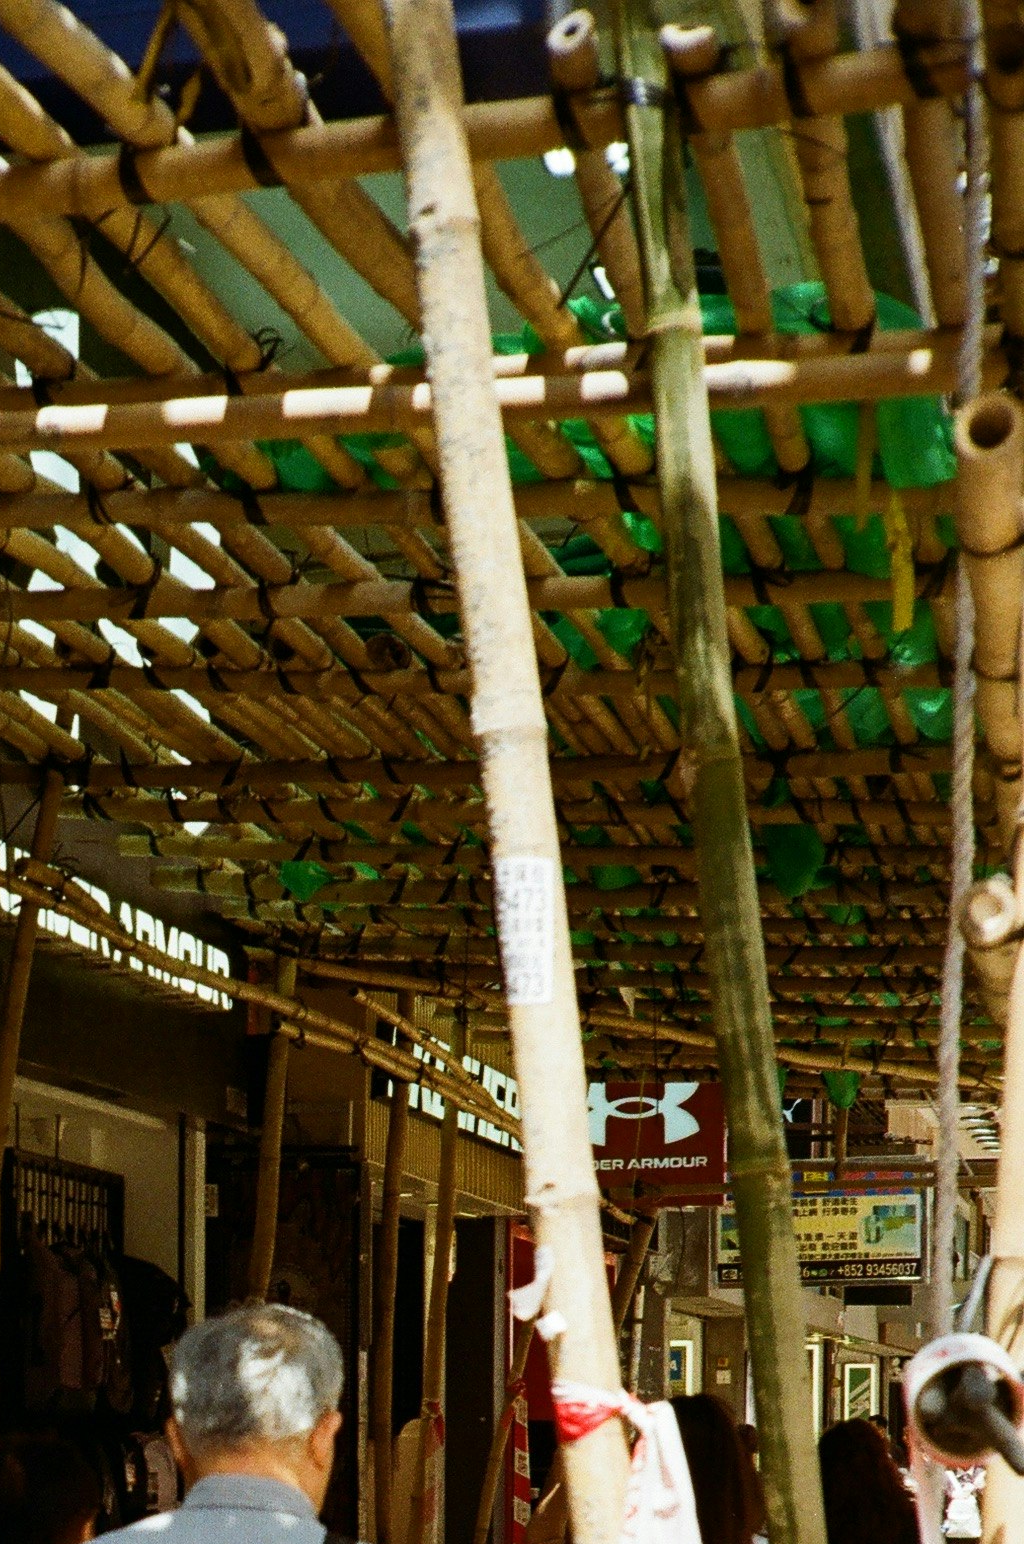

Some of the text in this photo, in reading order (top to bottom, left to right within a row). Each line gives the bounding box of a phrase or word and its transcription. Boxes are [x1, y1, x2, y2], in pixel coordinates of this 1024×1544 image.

[627, 1156, 709, 1170] ARMOUR
[837, 1263, 864, 1277] +852
[866, 1262, 918, 1277] 93456037
